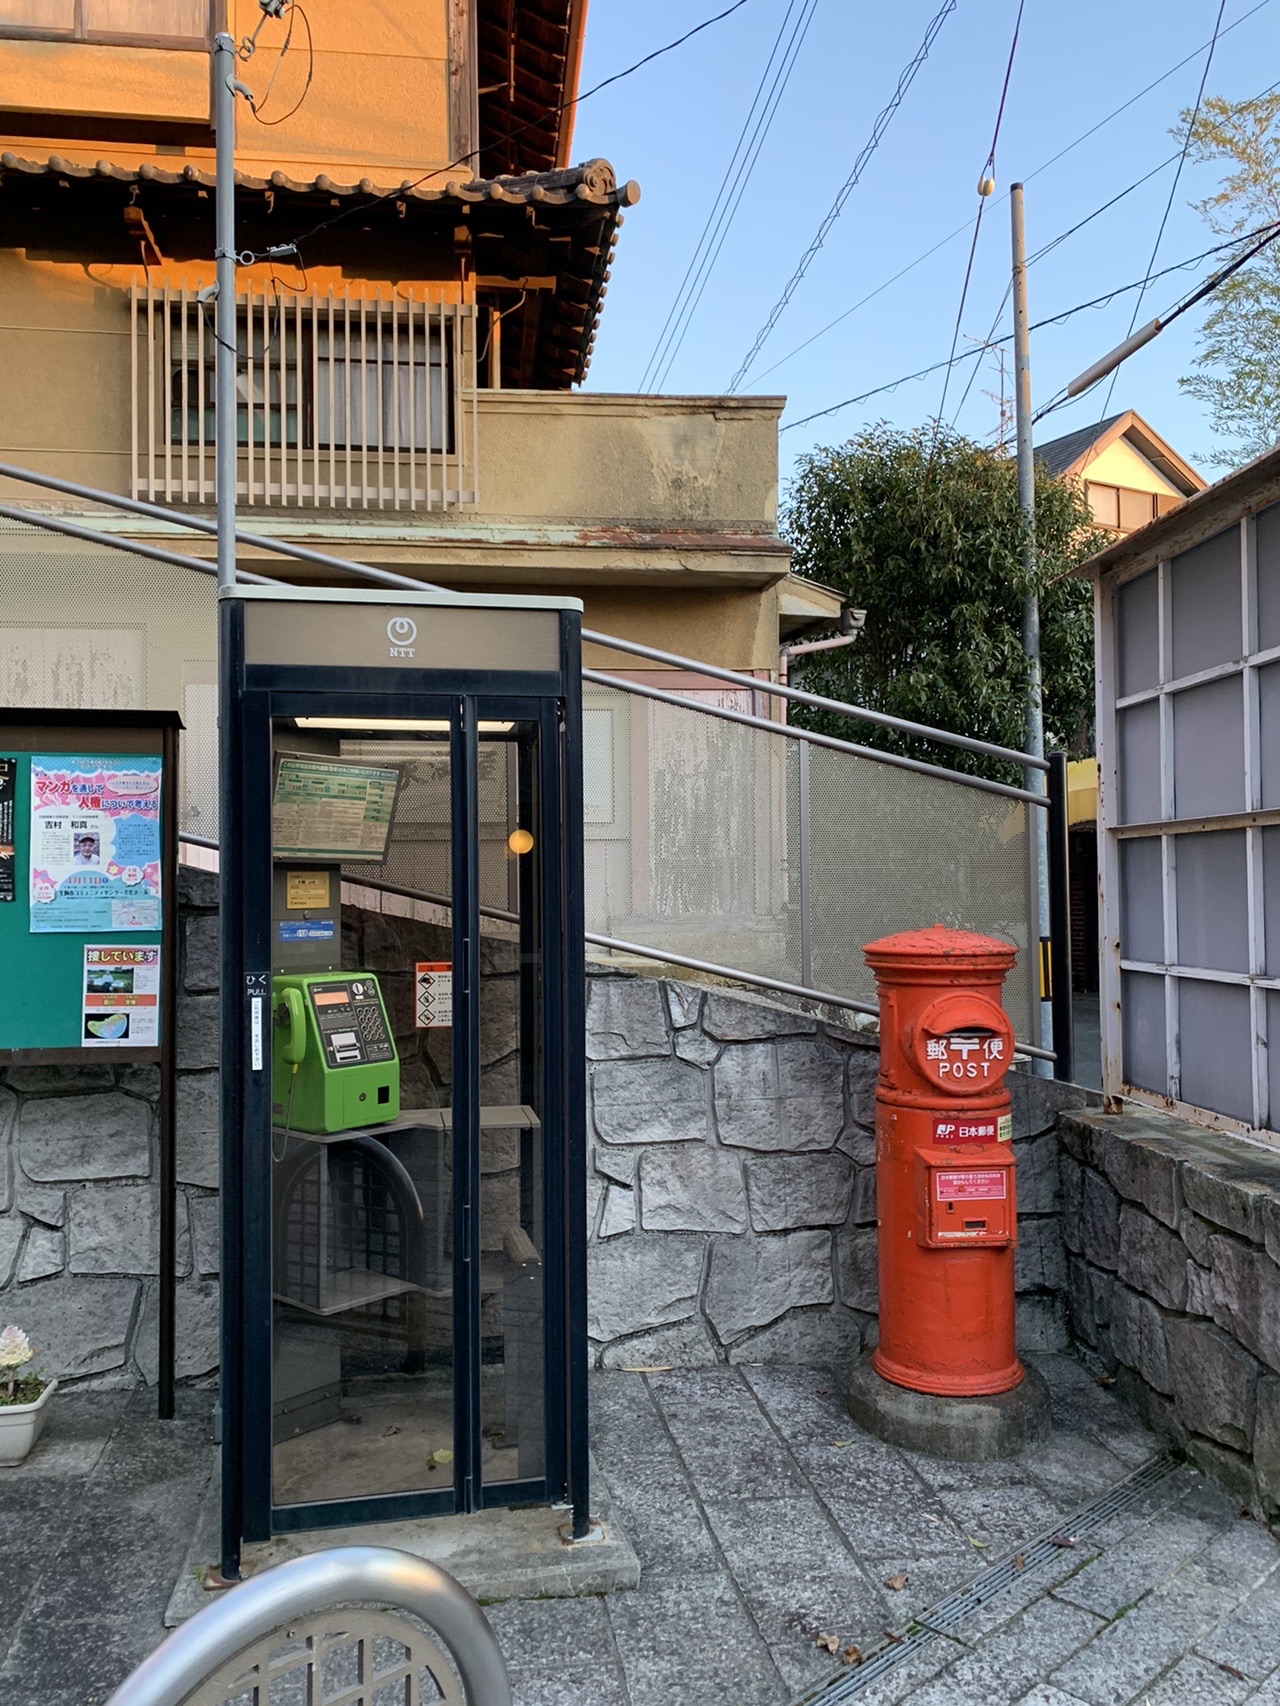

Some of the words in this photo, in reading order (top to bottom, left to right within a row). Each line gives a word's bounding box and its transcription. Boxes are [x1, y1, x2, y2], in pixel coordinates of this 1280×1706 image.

[389, 647, 415, 658] NTT
[35, 780, 104, 794] マンガを通して
[79, 795, 158, 810] 人権について考える
[246, 974, 267, 985] ひく
[246, 988, 267, 996] PULL
[939, 1062, 991, 1078] POST
[958, 1125, 995, 1138] 日本郵便
